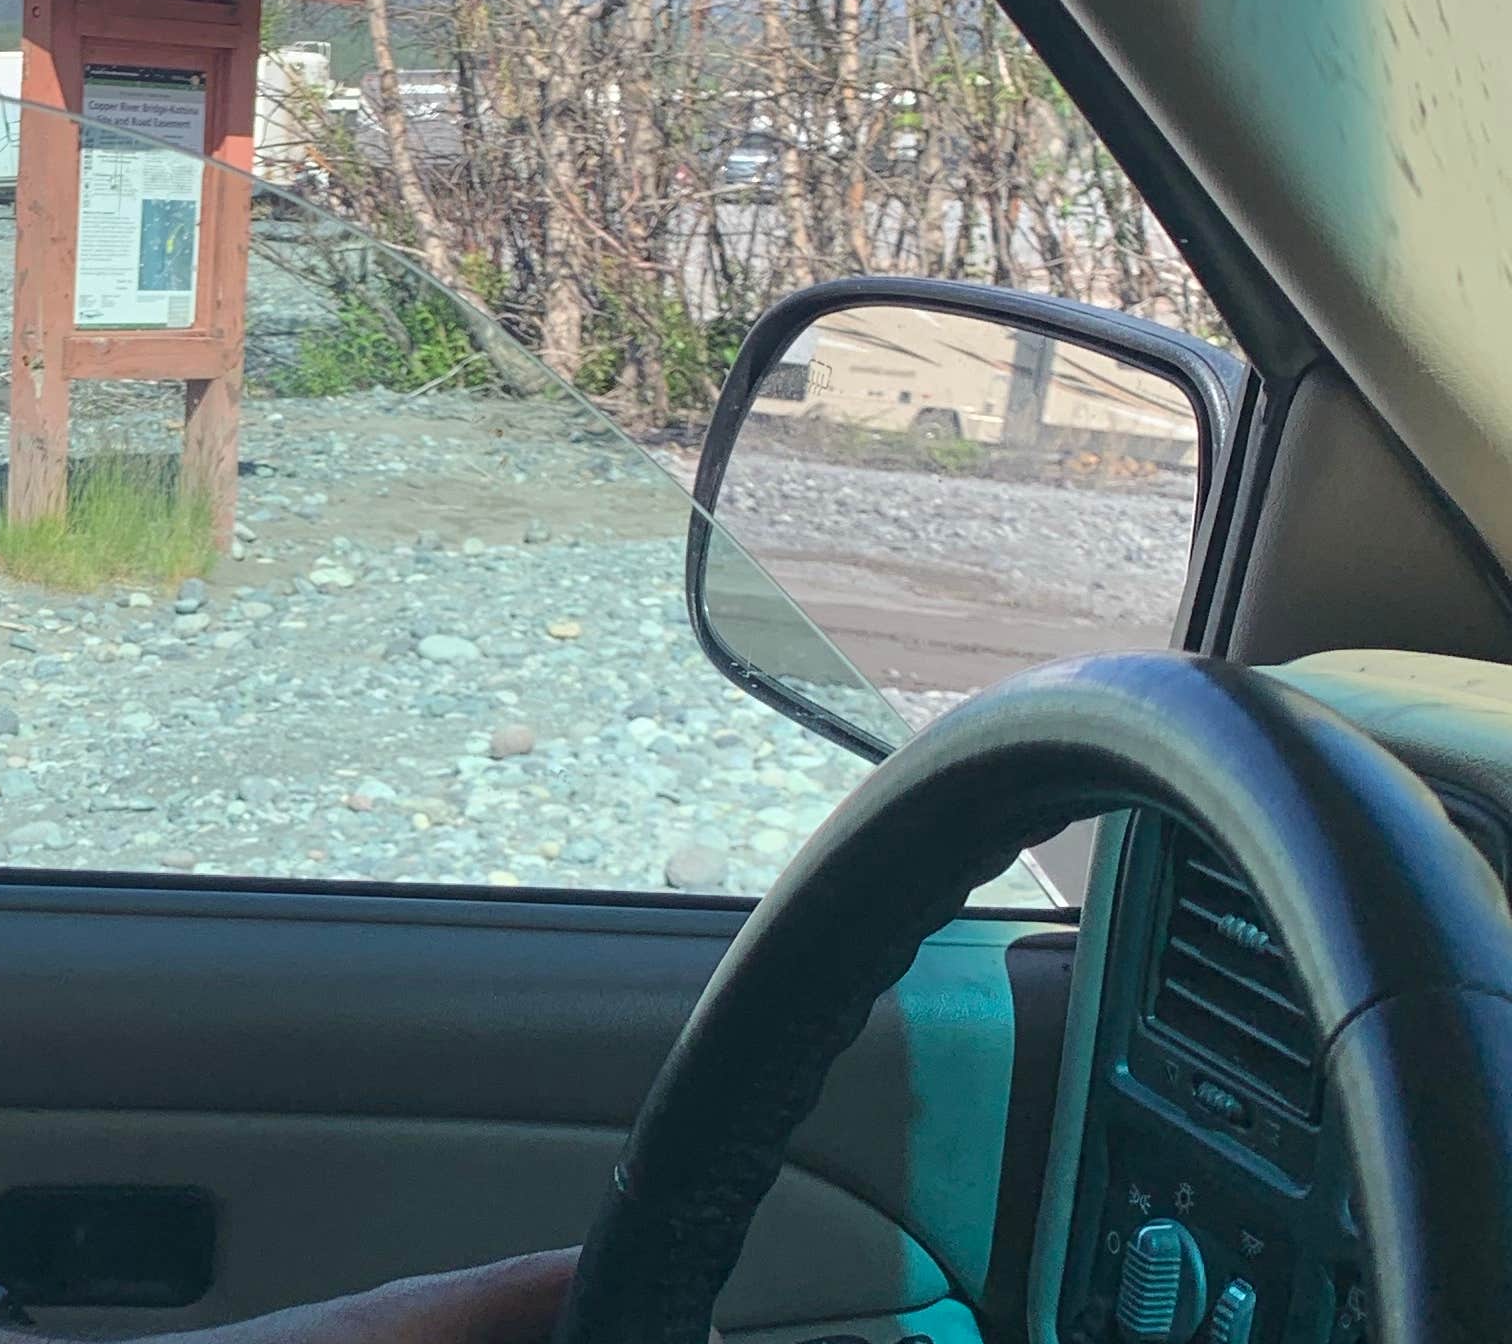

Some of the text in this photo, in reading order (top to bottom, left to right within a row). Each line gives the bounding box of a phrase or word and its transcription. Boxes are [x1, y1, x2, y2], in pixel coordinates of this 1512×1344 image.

[88, 100, 119, 113] Copper
[120, 102, 141, 112] River
[114, 116, 129, 126] and
[131, 117, 152, 127] Road
[153, 118, 192, 129] Easement
